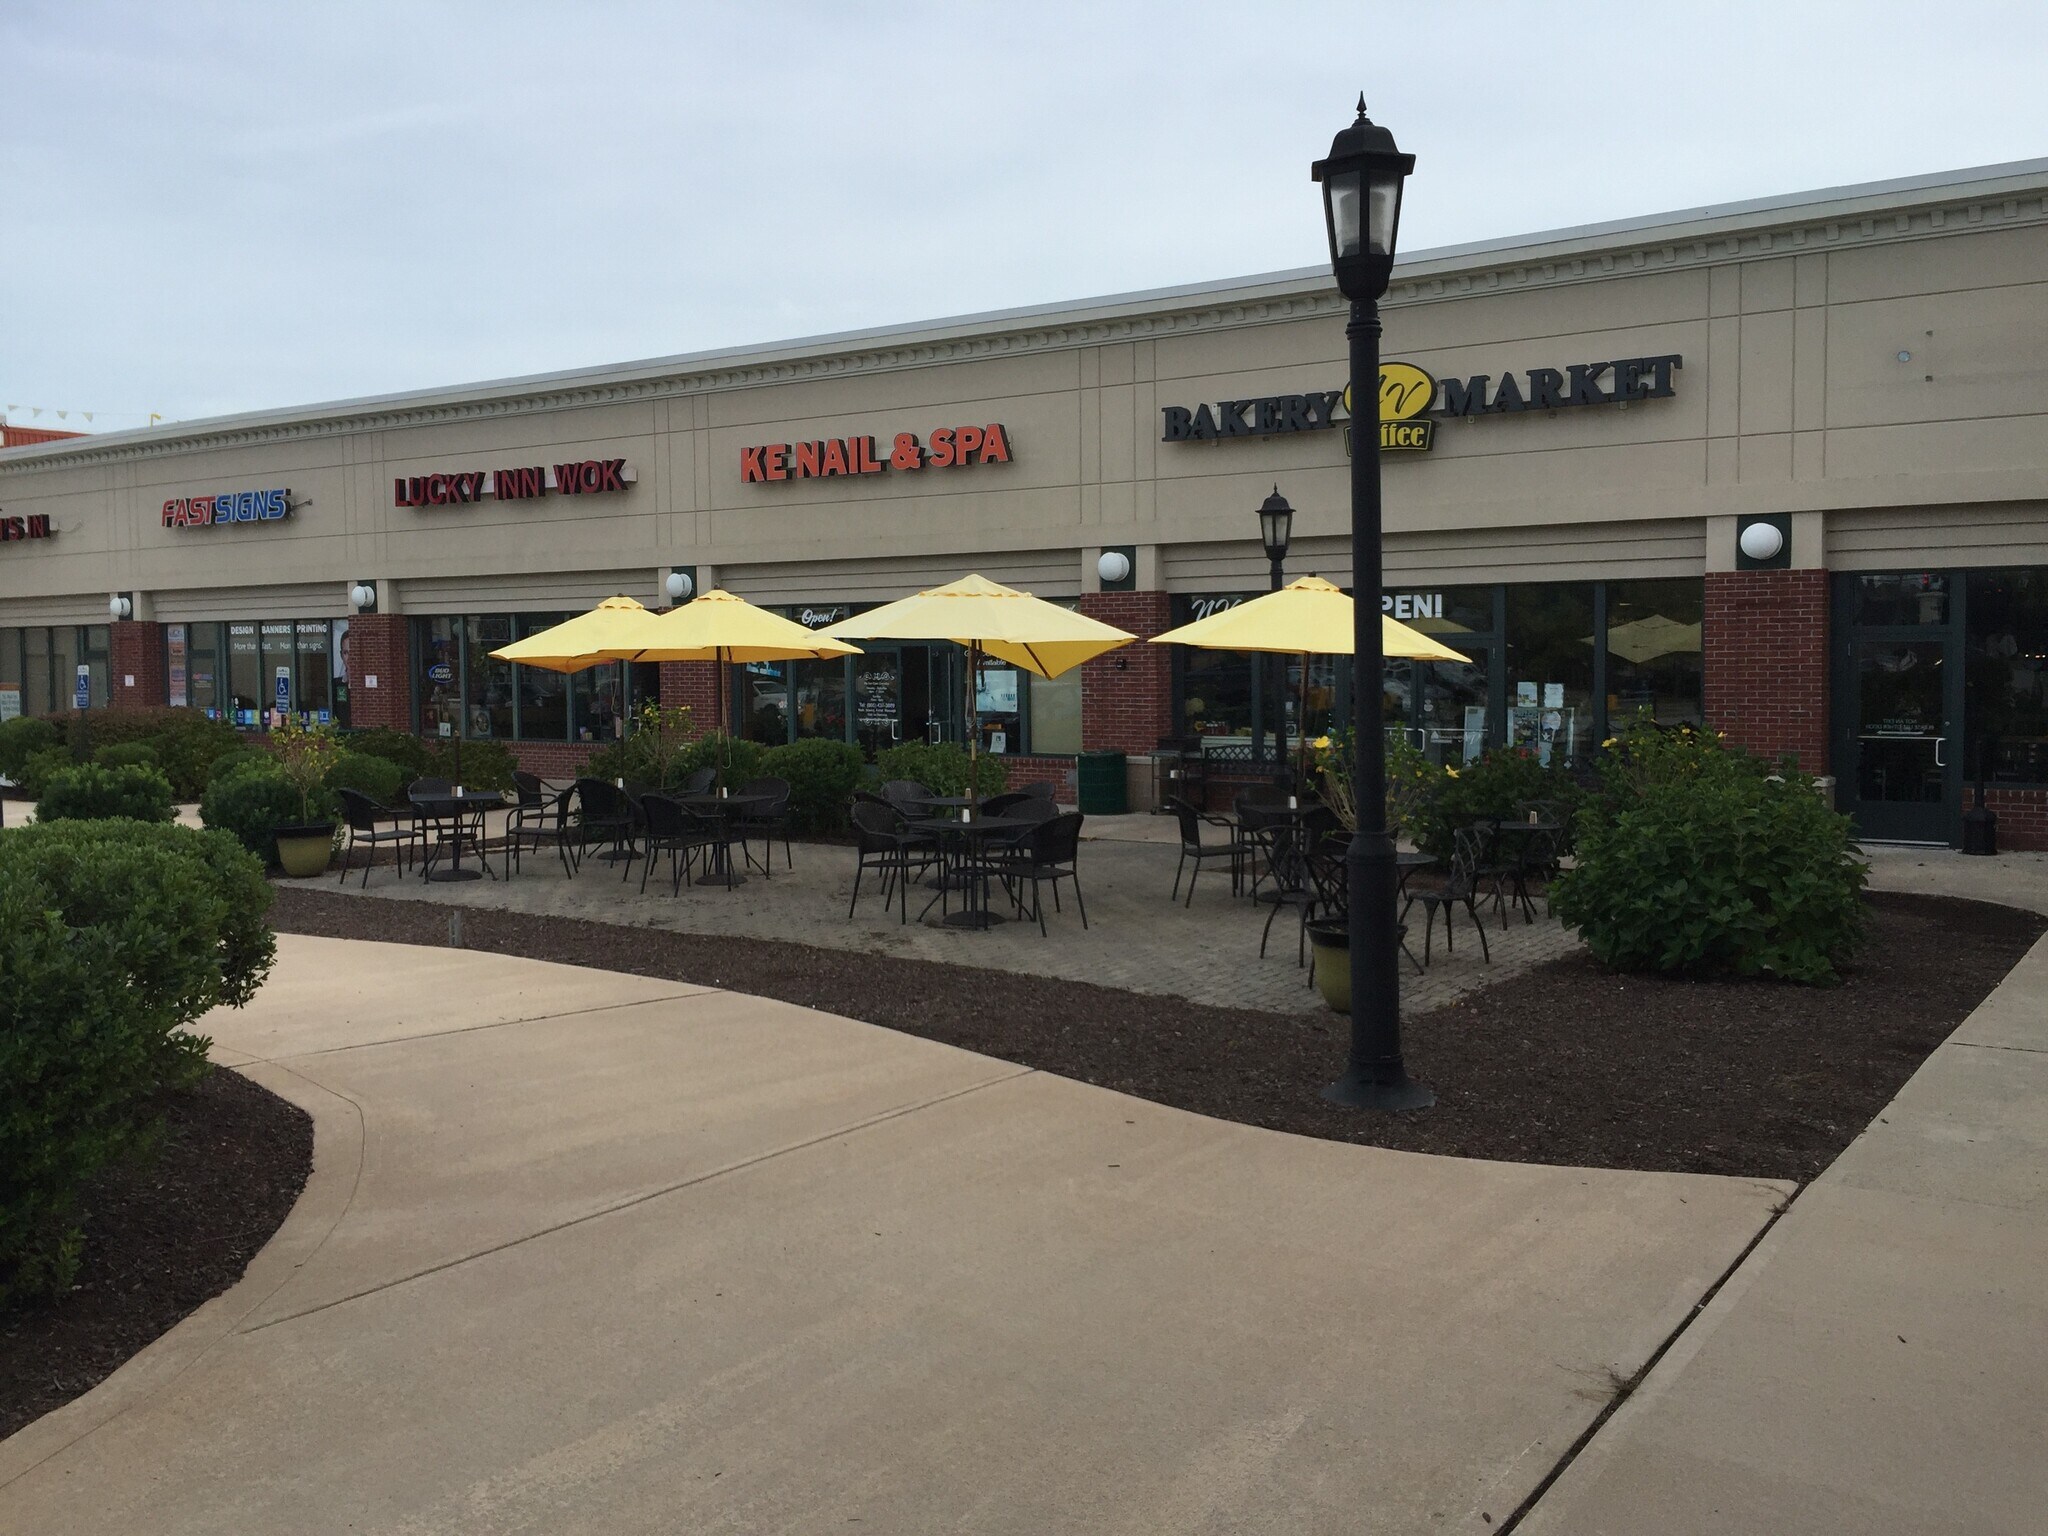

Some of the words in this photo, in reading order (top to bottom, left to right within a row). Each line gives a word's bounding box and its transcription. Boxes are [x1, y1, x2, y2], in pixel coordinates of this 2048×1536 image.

[1162, 391, 1342, 442] BAKERY
[1440, 354, 1682, 418] MARKET
[1380, 423, 1425, 447] ffee
[741, 444, 789, 483] KE
[796, 435, 882, 478] NAIL
[890, 432, 925, 470] &
[929, 423, 1013, 467] SPA
[394, 471, 486, 507] LUCKY
[493, 466, 546, 500] INN
[553, 459, 628, 495] WOK
[161, 489, 287, 527] FASTSIGNS
[801, 608, 837, 627] Open!
[1381, 594, 1442, 619] PEN!
[231, 626, 254, 635] DESIGN
[261, 625, 291, 634] BANNERS
[296, 624, 328, 633] PRINTING
